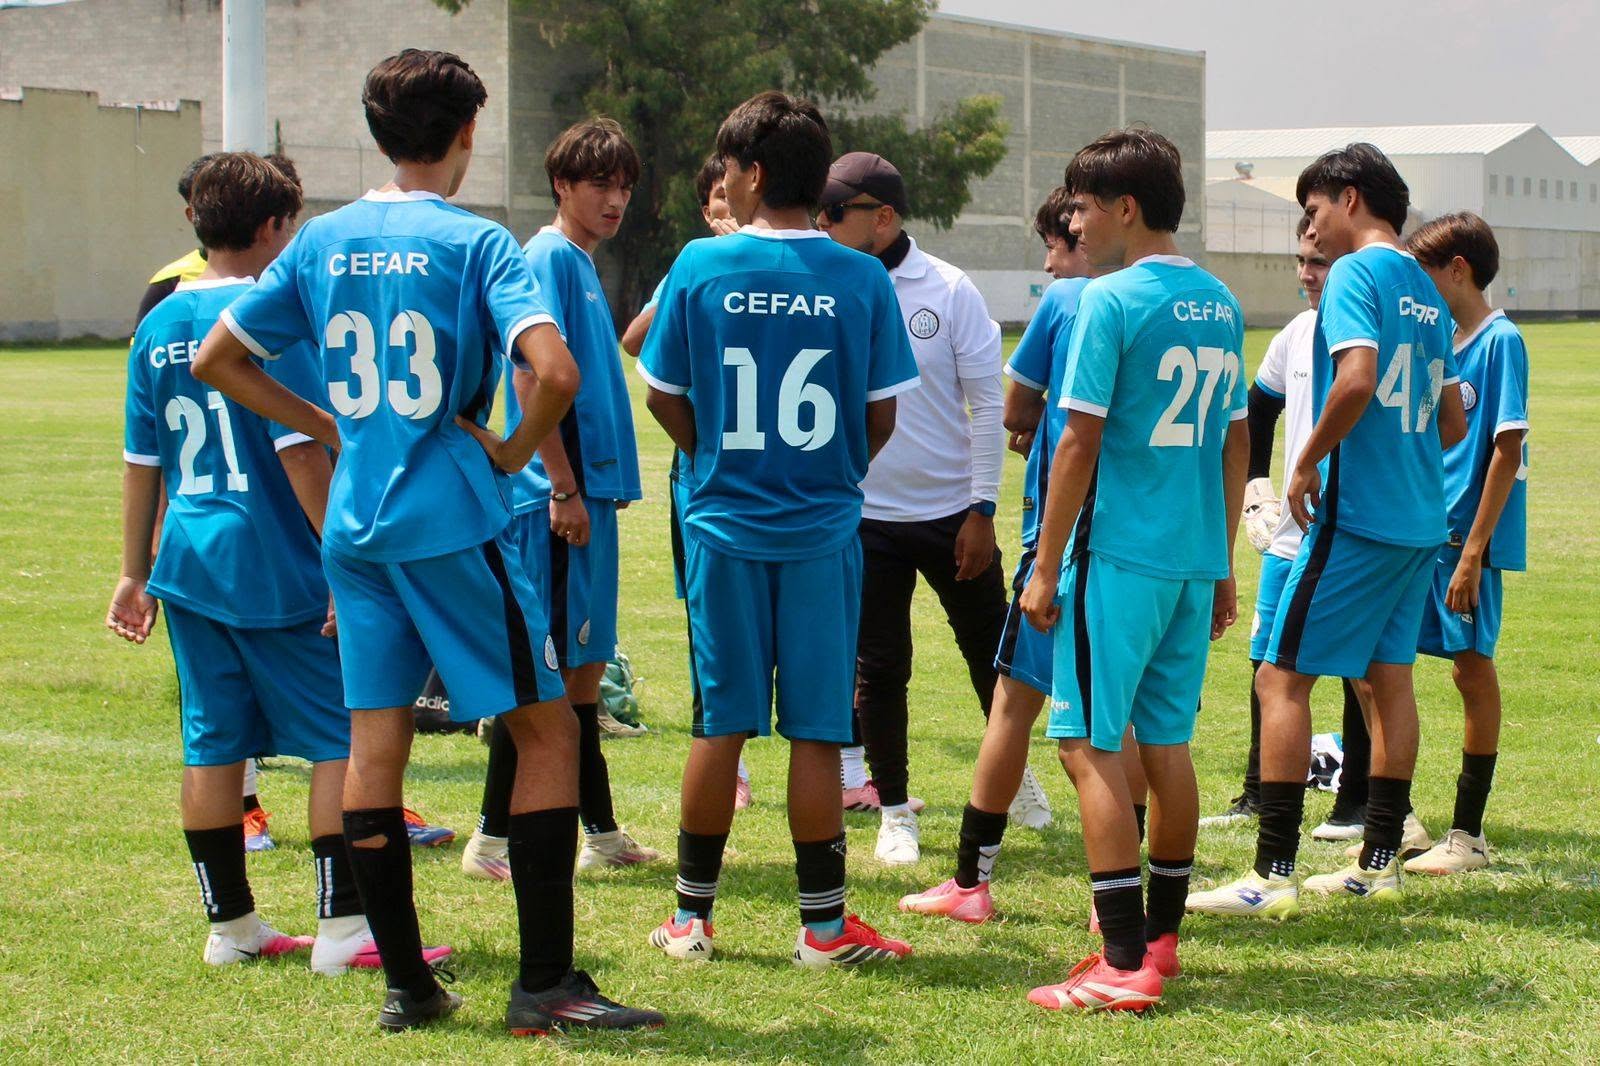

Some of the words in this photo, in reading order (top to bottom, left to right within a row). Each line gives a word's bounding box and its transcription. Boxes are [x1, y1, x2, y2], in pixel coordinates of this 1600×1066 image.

[328, 252, 430, 277] CEFAR
[723, 291, 836, 318] CEFAR
[1173, 301, 1235, 327] CEFAR
[150, 339, 200, 369] CEF
[325, 310, 443, 420] 33
[722, 347, 837, 452] 16
[165, 391, 249, 495] 21
